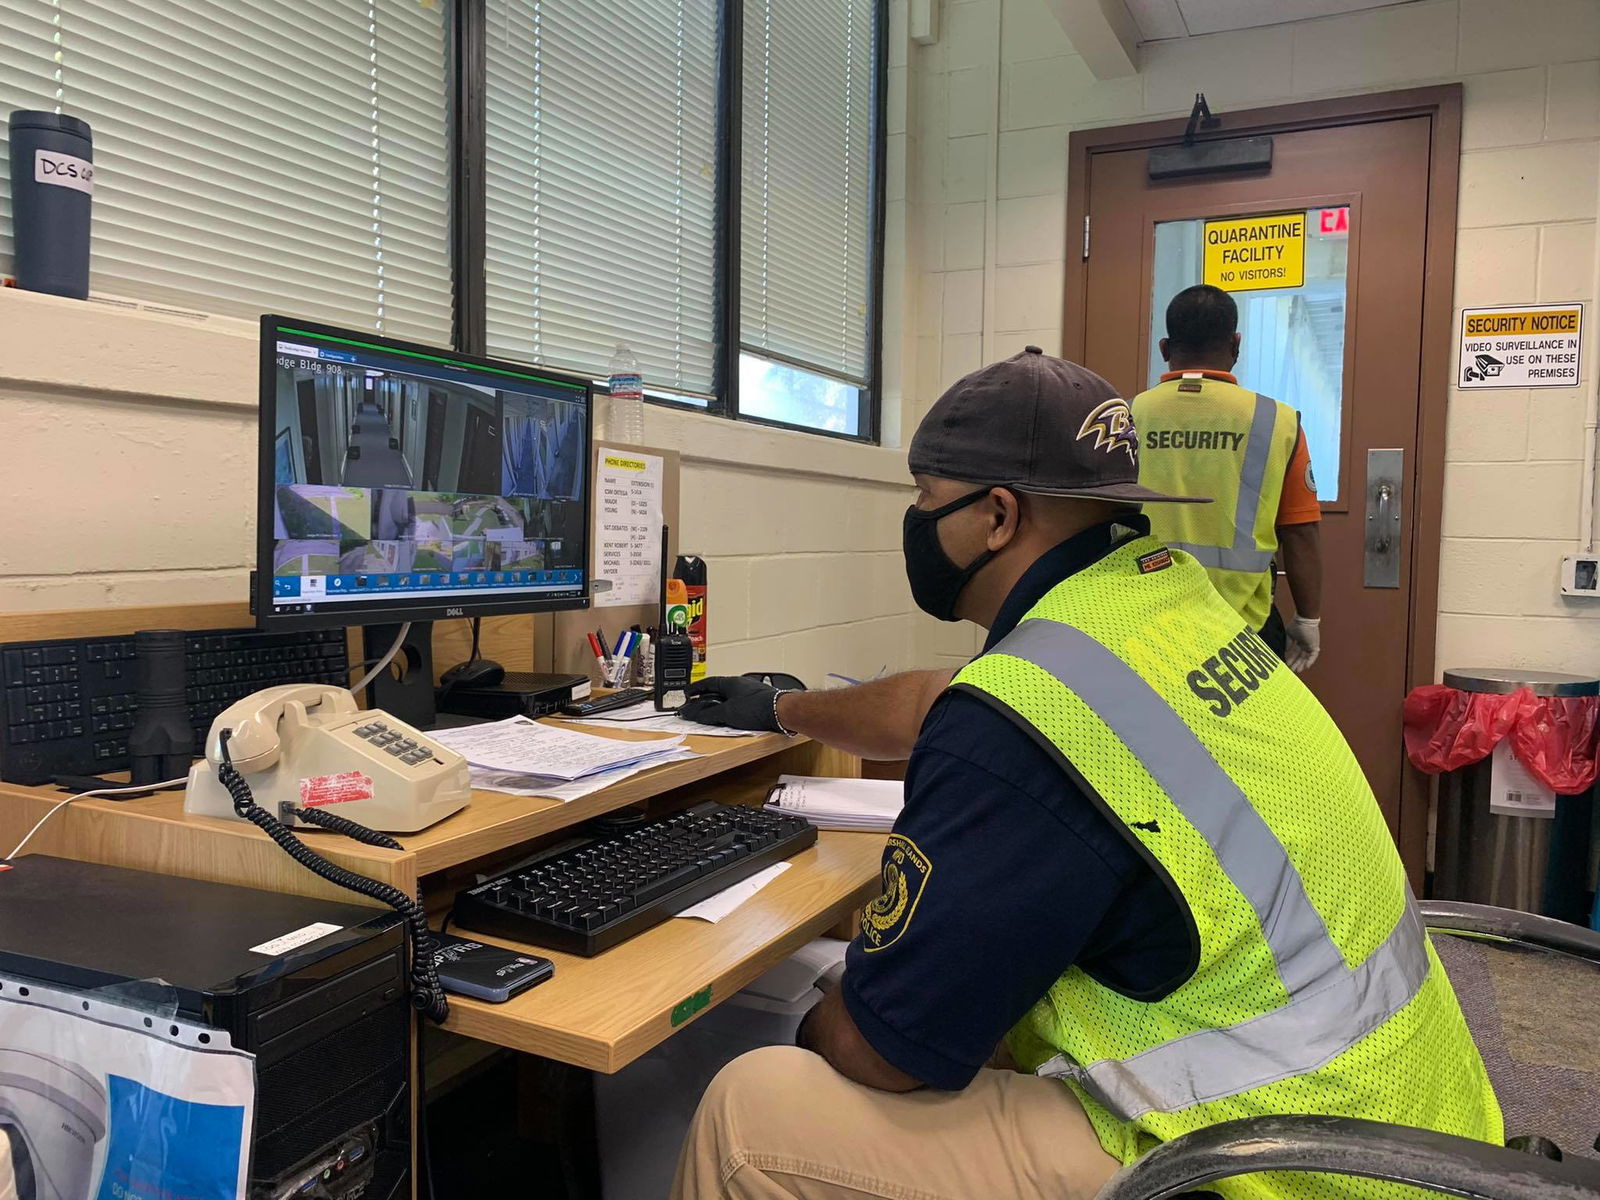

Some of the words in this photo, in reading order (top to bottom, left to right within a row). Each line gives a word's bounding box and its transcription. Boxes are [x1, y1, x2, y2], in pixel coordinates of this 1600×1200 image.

[40, 158, 78, 178] DCS
[1208, 222, 1301, 245] QUARANTINE
[1222, 245, 1285, 264] FACILITY
[1220, 271, 1235, 282] NO
[1239, 268, 1286, 281] VISITORS!
[1467, 317, 1527, 333] SECURITY
[1531, 315, 1576, 330] NOTICE
[1465, 342, 1492, 352] VIDEO
[1495, 340, 1563, 351] SURVEILLANCE
[1568, 340, 1577, 348] IN
[1506, 355, 1524, 364] USE
[1528, 355, 1542, 364] ON
[1546, 353, 1576, 363] THESE
[300, 359, 321, 373] Bldg
[326, 363, 342, 375] 908
[1528, 368, 1575, 378] PREMISES
[1146, 430, 1244, 451] SECURITY
[447, 608, 463, 616] DELL
